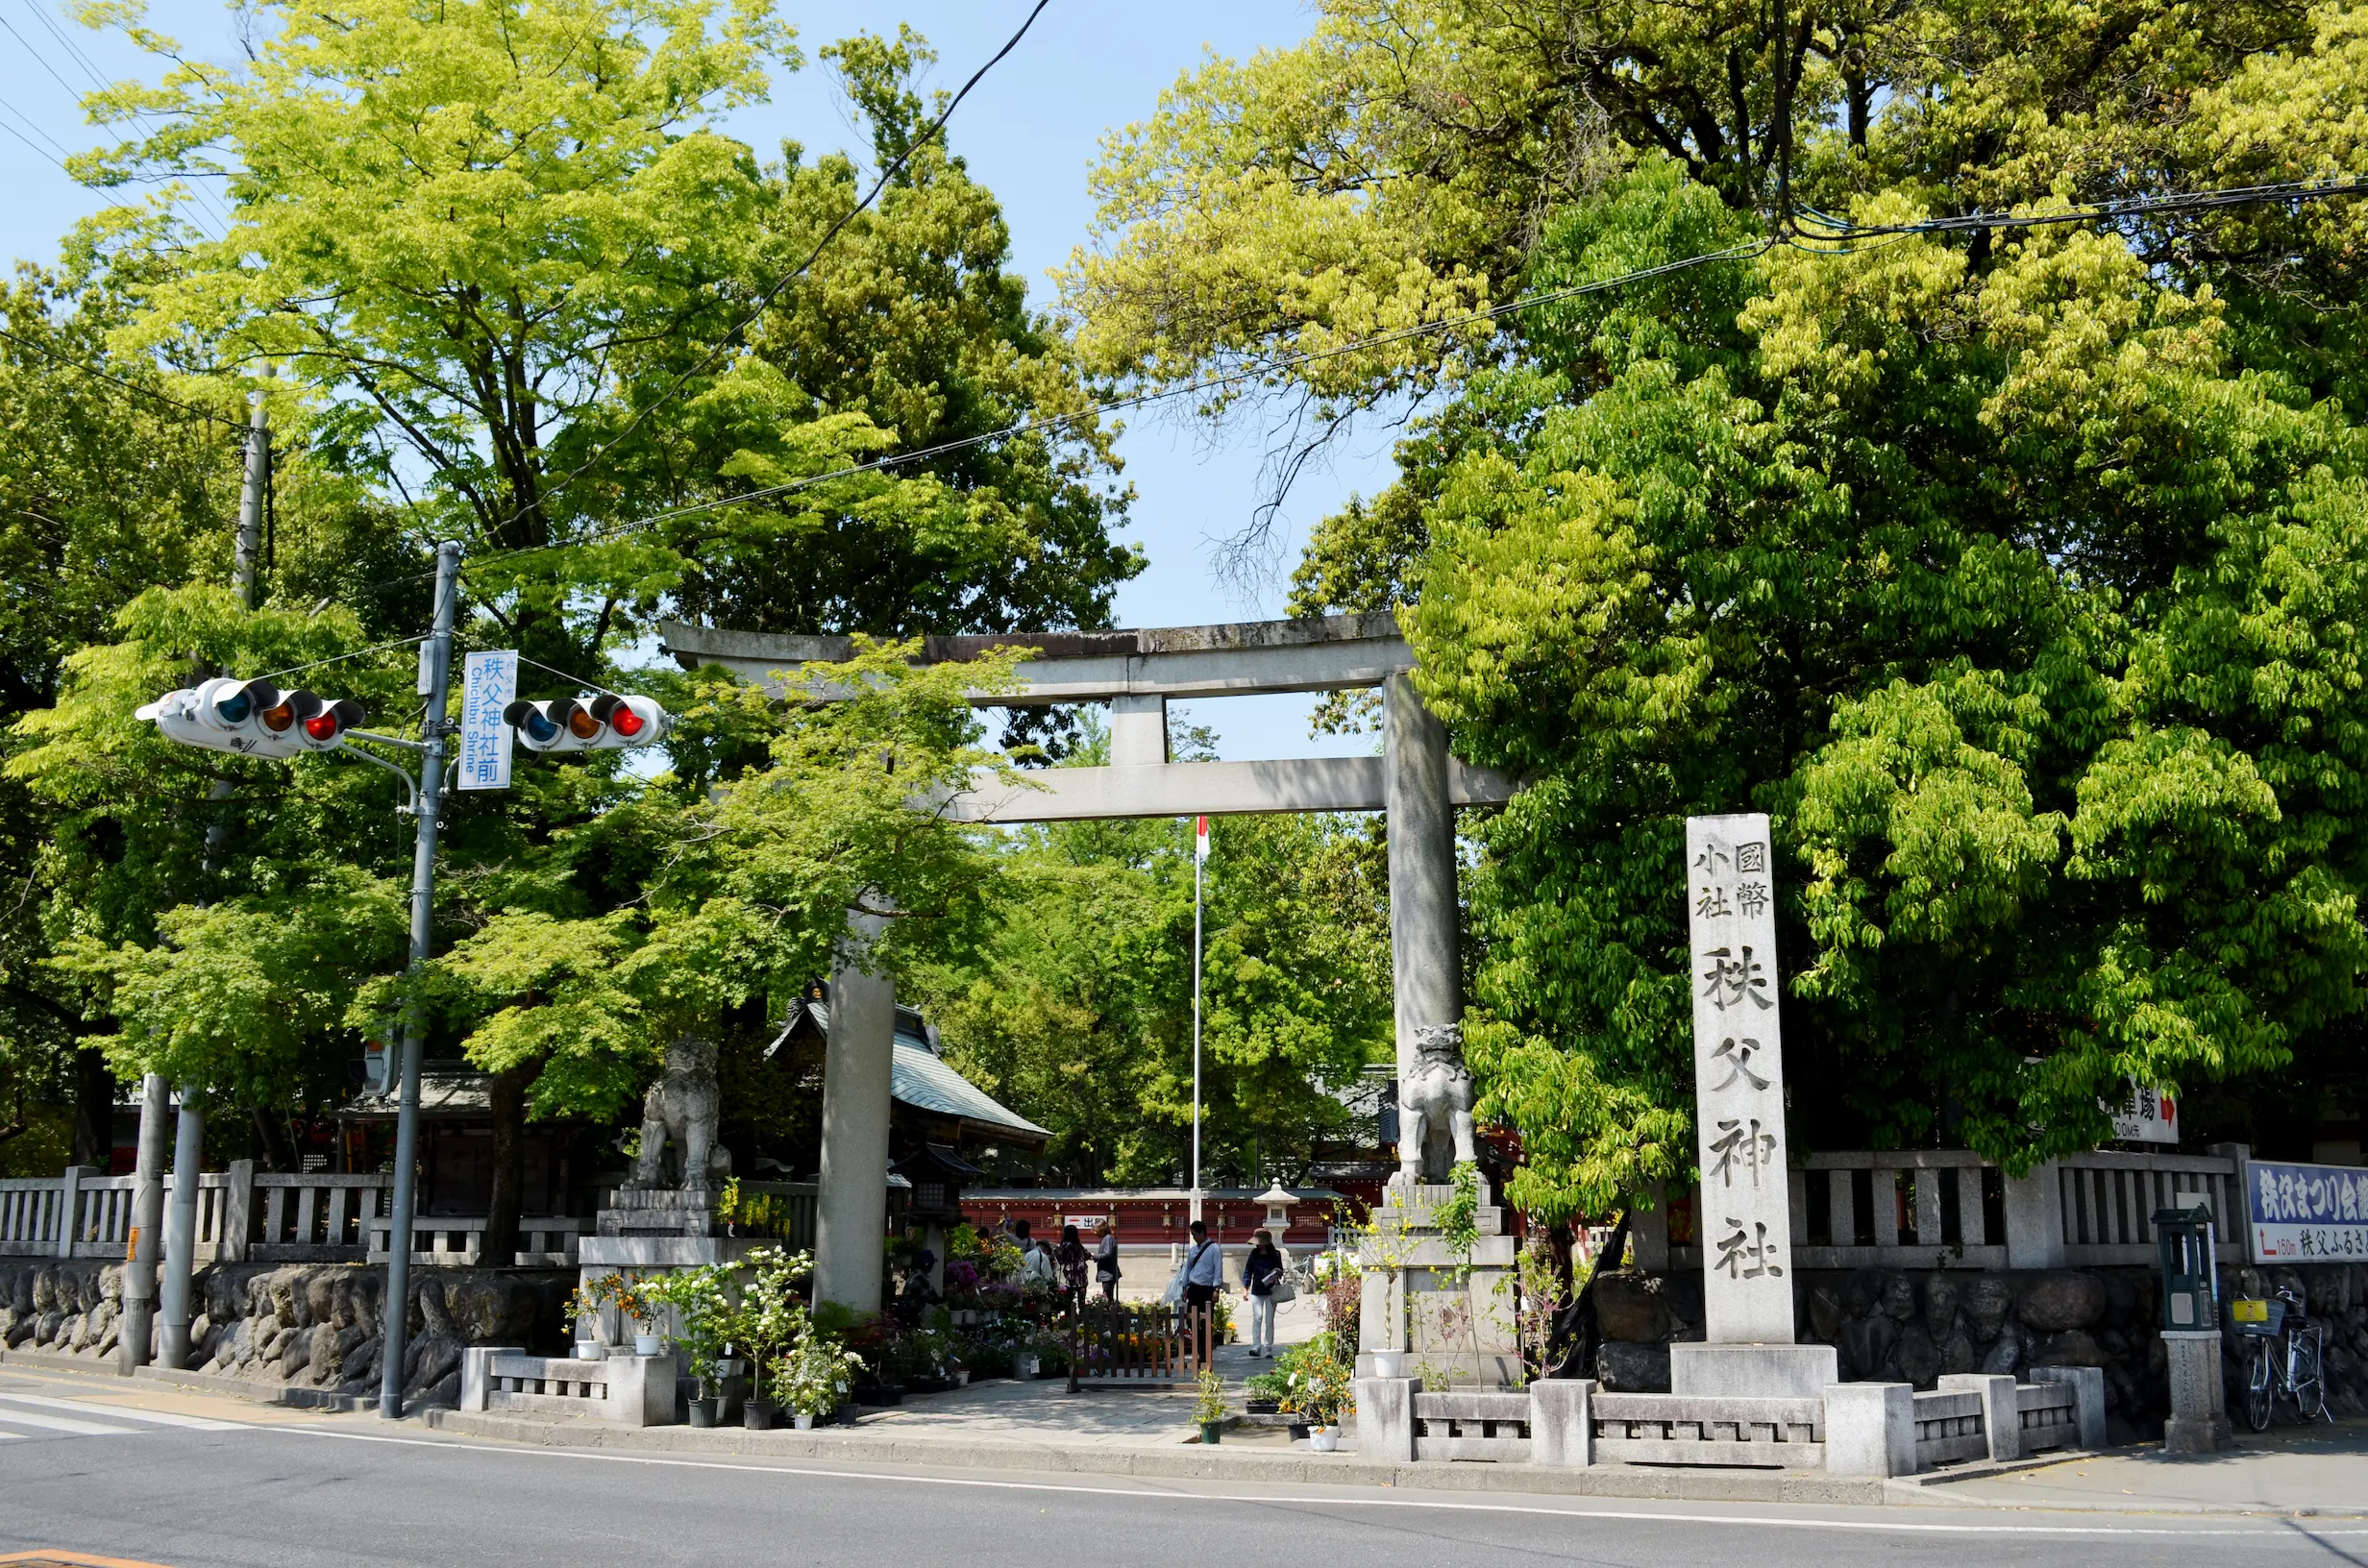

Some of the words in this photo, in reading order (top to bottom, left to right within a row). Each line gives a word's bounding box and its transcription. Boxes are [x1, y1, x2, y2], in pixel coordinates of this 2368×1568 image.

[468, 667, 482, 724] Chichibu
[478, 657, 505, 783] 秩父神社前
[465, 731, 479, 773] Shrine
[1693, 844, 1733, 919] 小社
[1702, 944, 1784, 1281] 秩父神社
[2277, 1238, 2297, 1256] 150m
[2300, 1229, 2368, 1257] 秩父ふるさ
